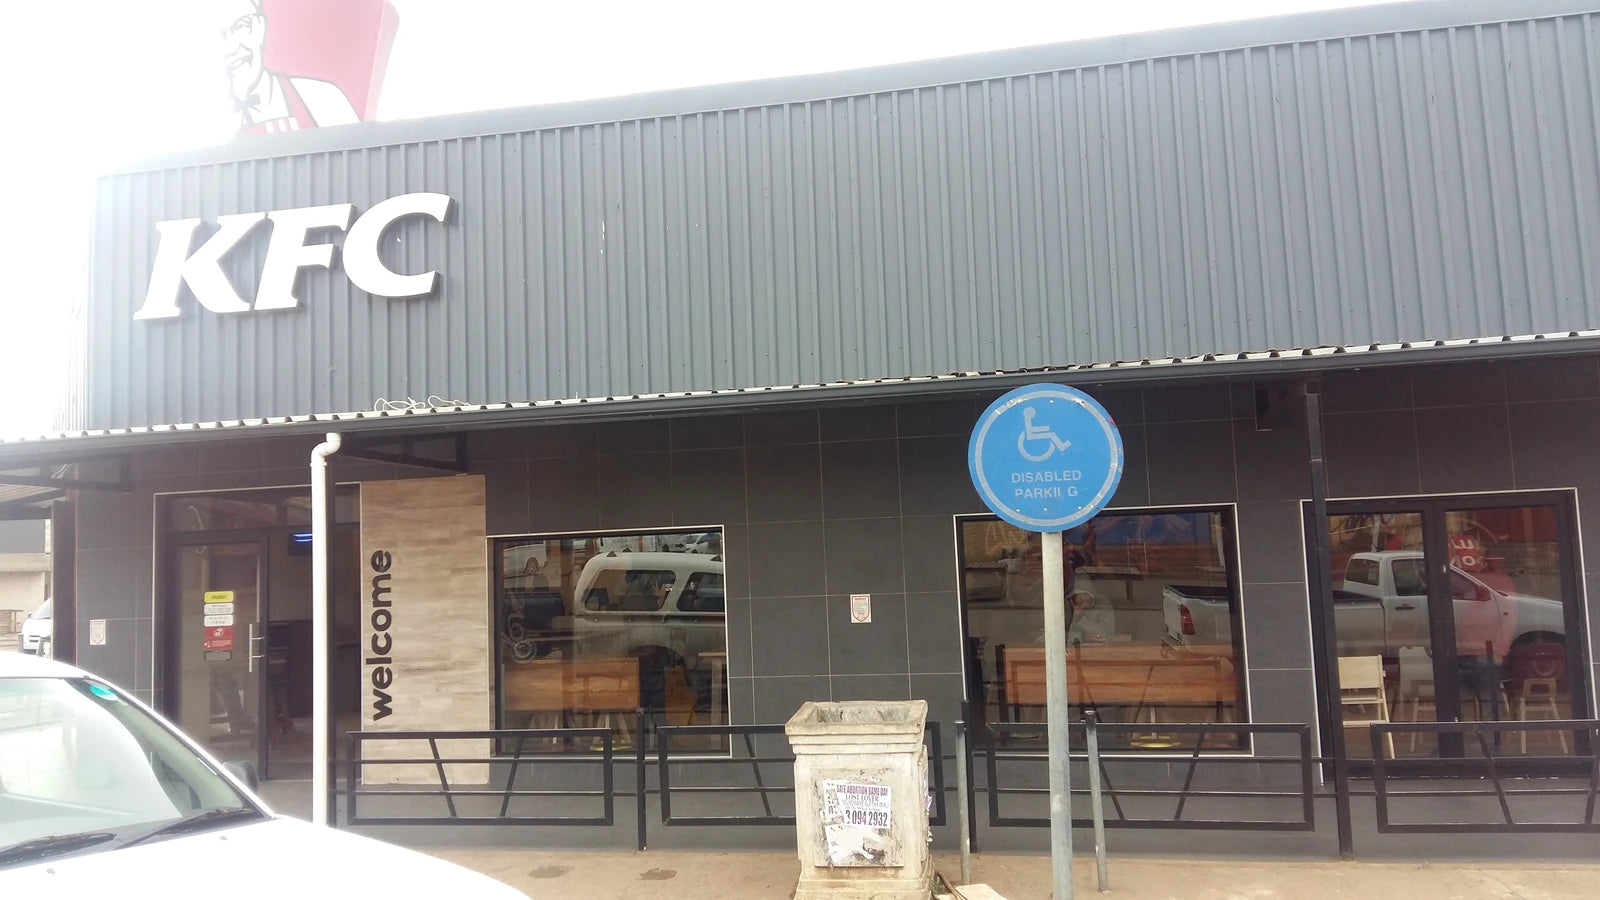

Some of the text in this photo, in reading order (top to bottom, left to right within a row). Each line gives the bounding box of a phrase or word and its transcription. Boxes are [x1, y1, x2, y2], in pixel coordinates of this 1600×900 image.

[133, 192, 453, 321] KFC
[1011, 470, 1082, 484] DISABLED
[365, 550, 393, 721] welcome
[836, 784, 889, 796] SAFE ABORTION SAME DAY
[852, 810, 867, 825] 094
[868, 811, 888, 827] 2932
